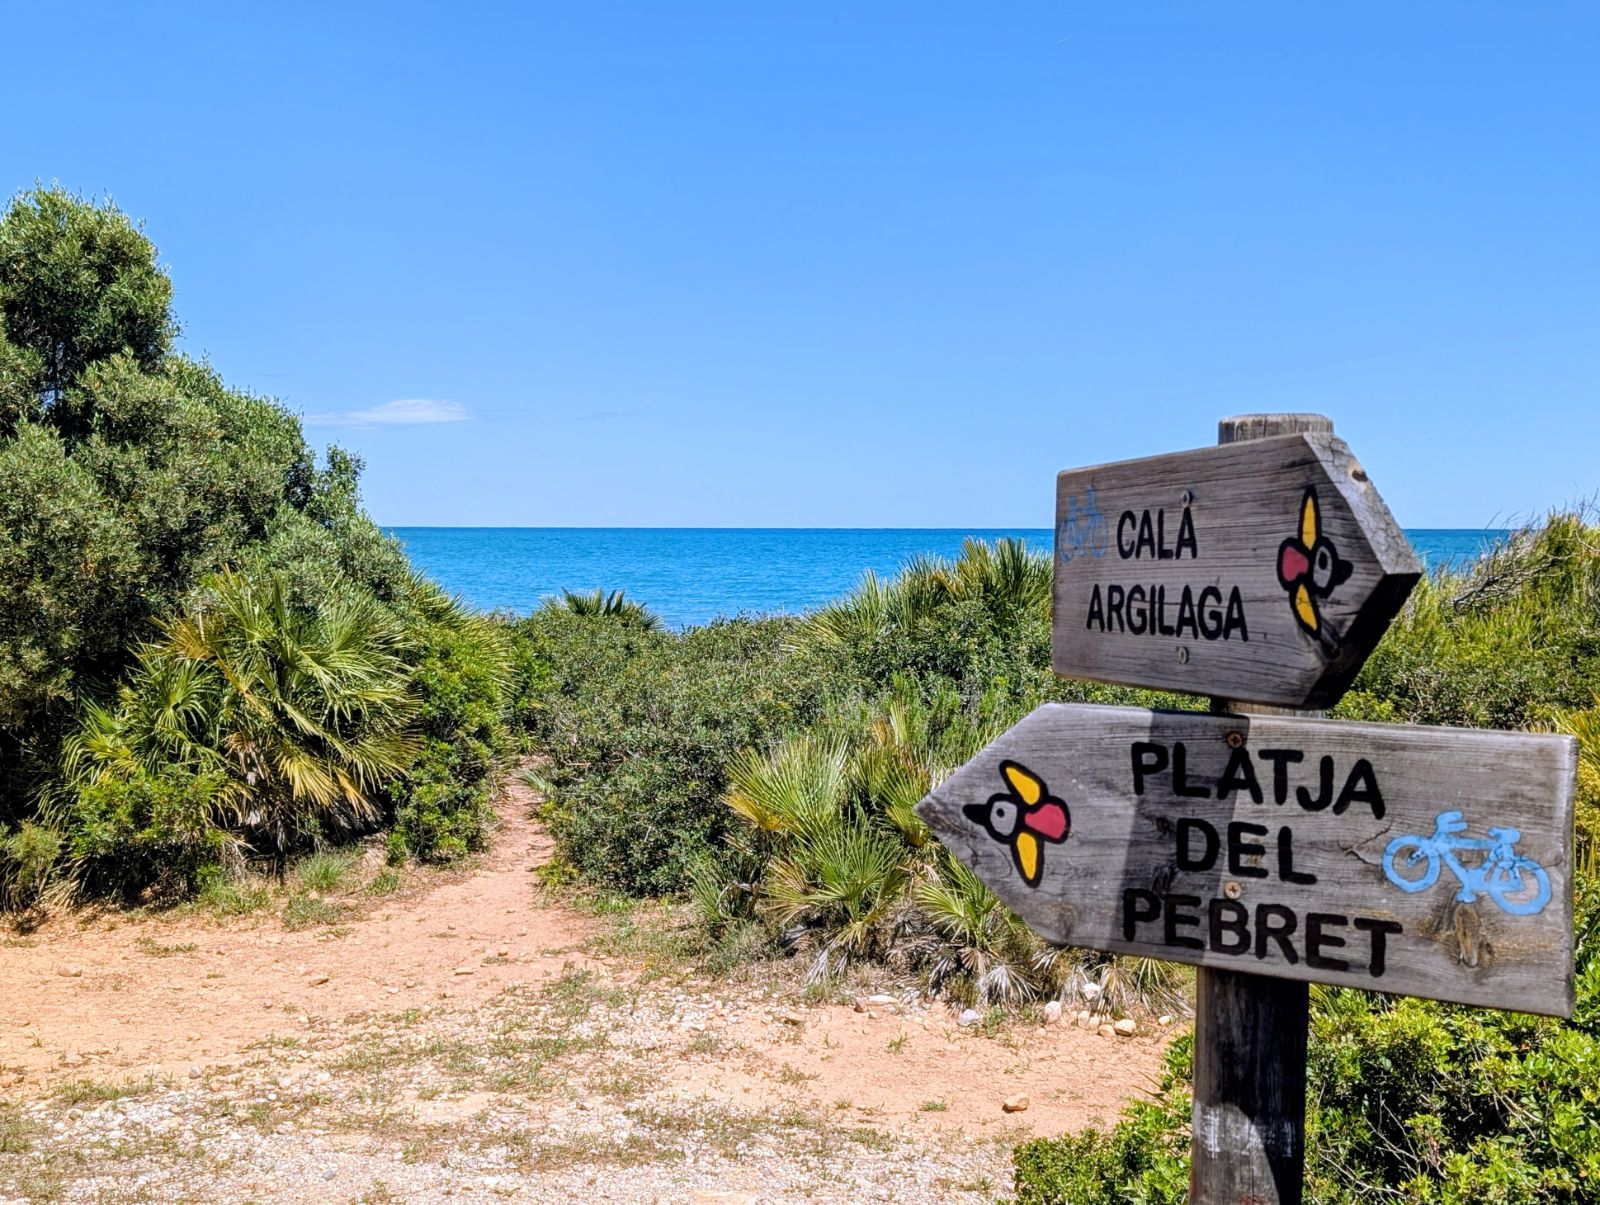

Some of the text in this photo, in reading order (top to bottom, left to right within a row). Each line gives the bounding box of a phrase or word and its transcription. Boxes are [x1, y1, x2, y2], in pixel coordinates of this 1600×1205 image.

[1117, 506, 1198, 560] CALA
[1086, 583, 1249, 642] ARGILAGA
[1130, 741, 1386, 820] PLATJA
[1176, 818, 1317, 885] DEL
[1123, 889, 1403, 977] PEBRET
